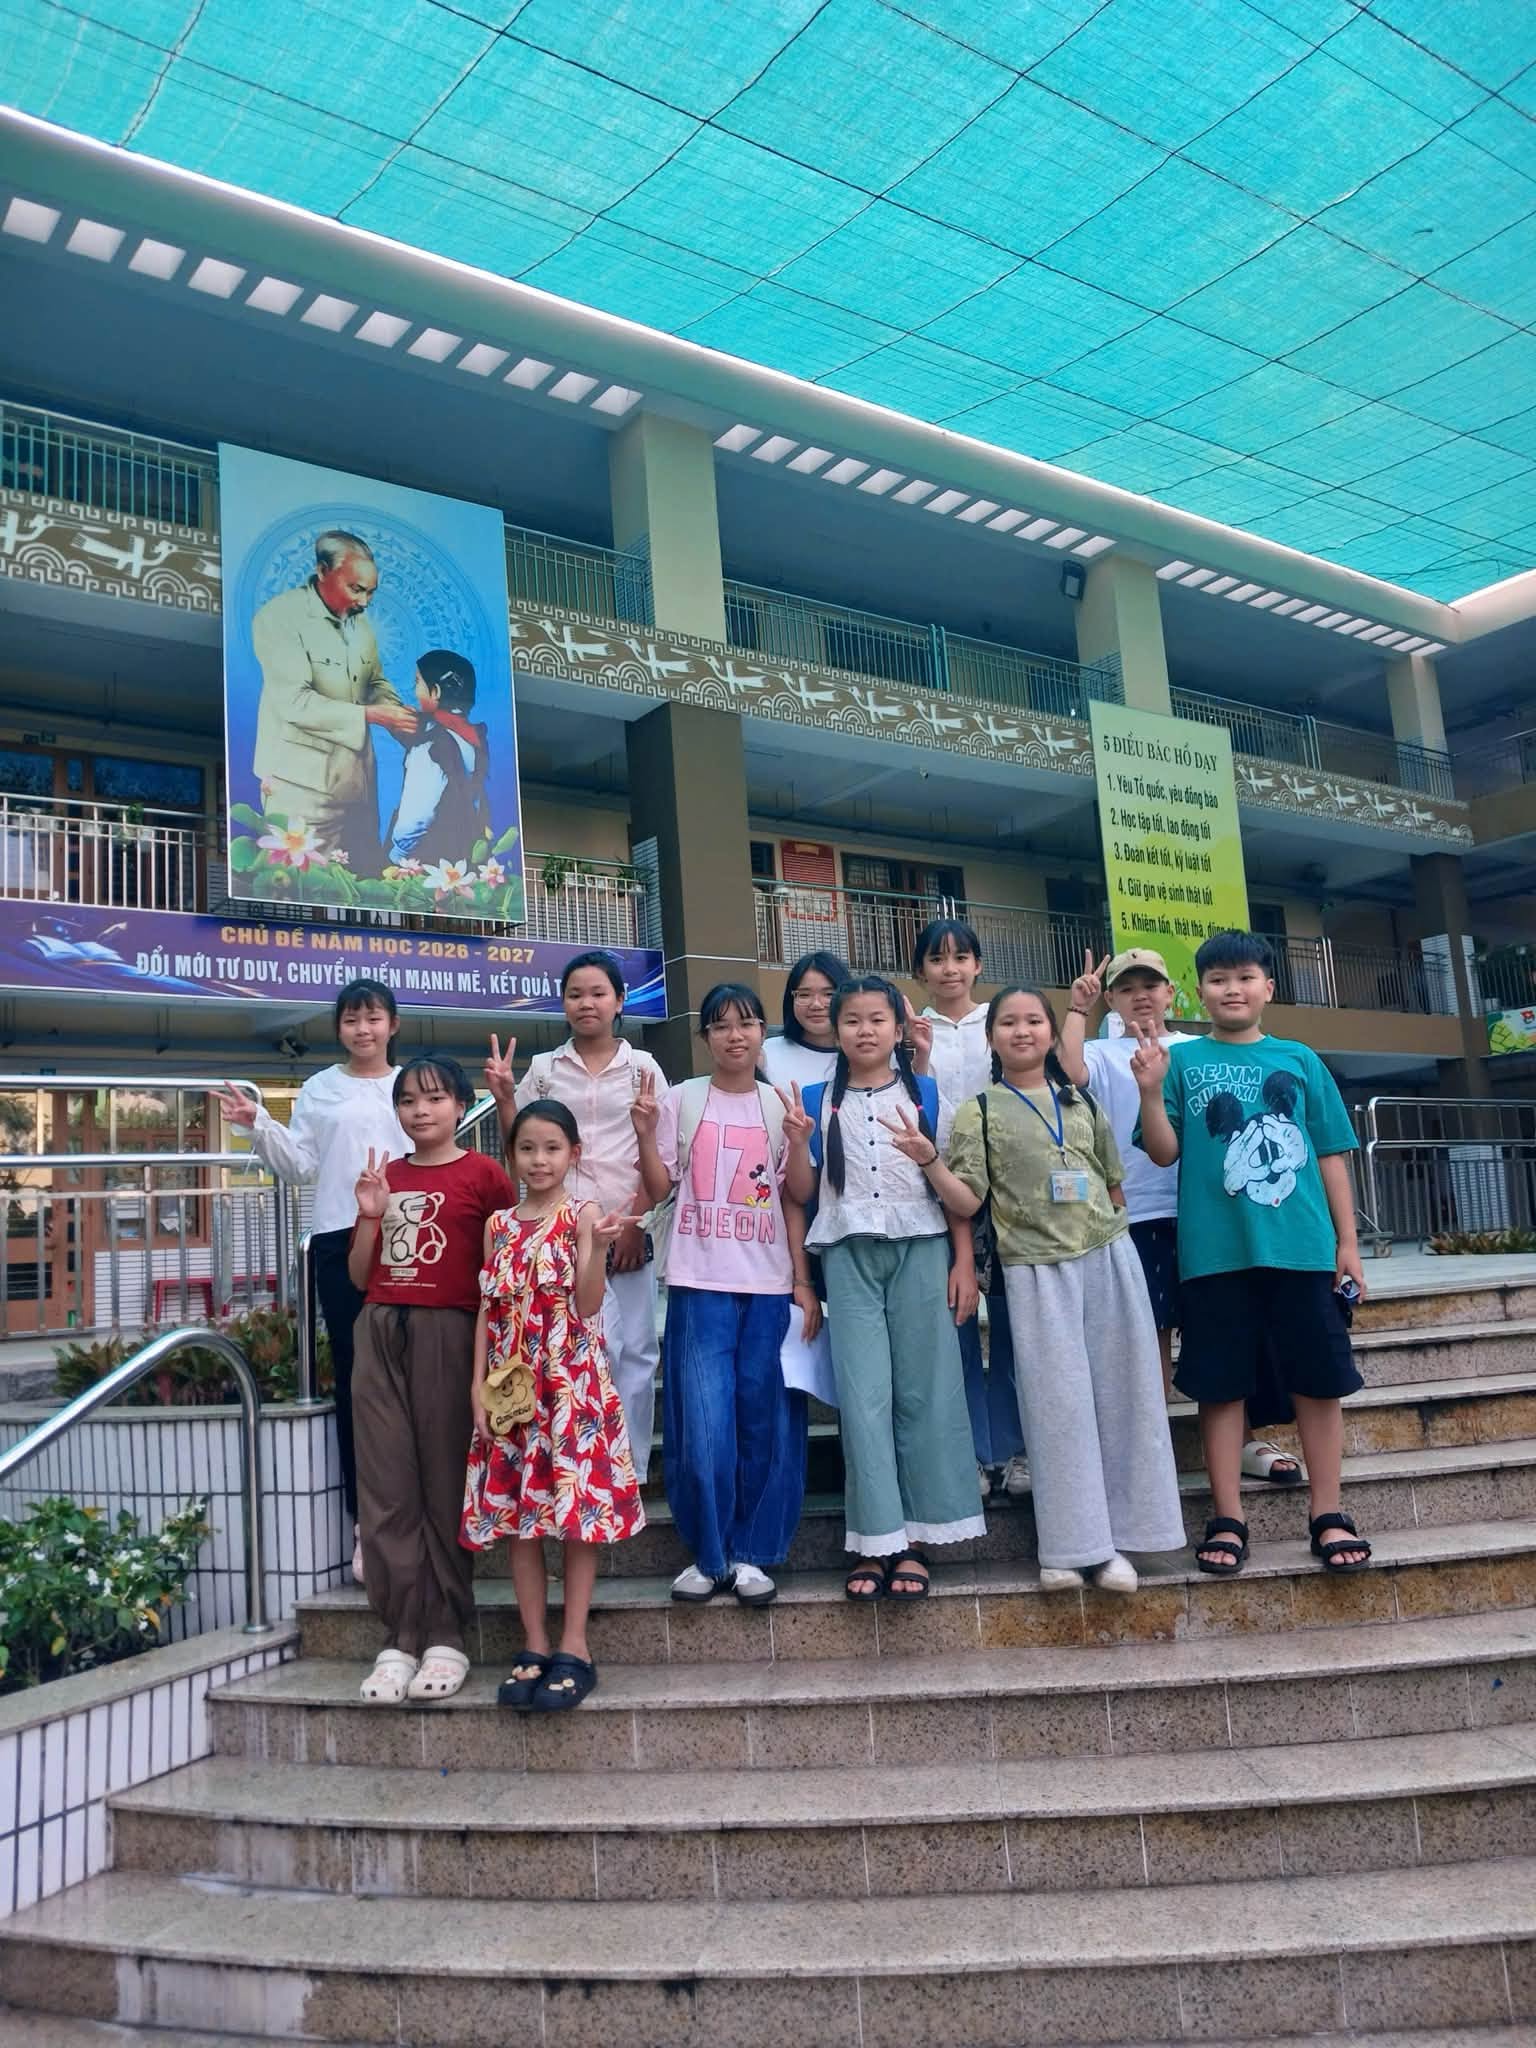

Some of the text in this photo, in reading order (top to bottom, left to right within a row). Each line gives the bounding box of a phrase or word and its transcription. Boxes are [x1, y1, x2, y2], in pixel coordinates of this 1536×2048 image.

[1103, 735, 1111, 752] 5
[1147, 740, 1171, 763] BÁC
[1195, 752, 1217, 774] DẠY
[1107, 773, 1116, 792] 1.
[1116, 775, 1133, 795] Yêu
[1169, 784, 1184, 805] yêu
[1110, 808, 1120, 826] 2.
[1120, 808, 1136, 830] Học
[1138, 812, 1151, 834] tập
[1167, 816, 1180, 835] lao
[1181, 818, 1200, 842] động
[1201, 818, 1211, 840] tốt
[1114, 842, 1123, 860] 3.
[1124, 843, 1145, 864] Đoàn
[1146, 845, 1159, 865] kết
[1160, 848, 1174, 870] tốt,
[1185, 852, 1200, 875] luật
[1201, 852, 1212, 872] tốt
[1118, 877, 1127, 895] 4.
[1127, 878, 1141, 897] Giữ
[1157, 882, 1167, 904] vệ
[1169, 883, 1185, 901] sinh
[1186, 885, 1201, 908] thật
[1202, 886, 1213, 906] tốt
[1121, 912, 1130, 931] 5.
[1131, 912, 1157, 934] Khiêm
[1174, 916, 1189, 940] thật
[221, 924, 269, 946] CHỦ
[275, 927, 305, 948] ĐỀ
[311, 931, 363, 953] NĂM
[369, 936, 413, 957] HỌC
[418, 941, 469, 959] 2026
[487, 946, 535, 963] 2027
[136, 945, 169, 977] ĐỔI
[175, 952, 212, 978] MỚI
[216, 957, 240, 979] TƯ
[244, 959, 282, 984] DUY,
[287, 957, 357, 985] CHUYỂN
[405, 969, 453, 994] MẠNH
[457, 970, 487, 995] MẼ,
[490, 969, 518, 994] KẾT
[521, 971, 552, 997] QUẢ
[1184, 1063, 1263, 1090] BEJVM
[691, 1120, 770, 1206] 17
